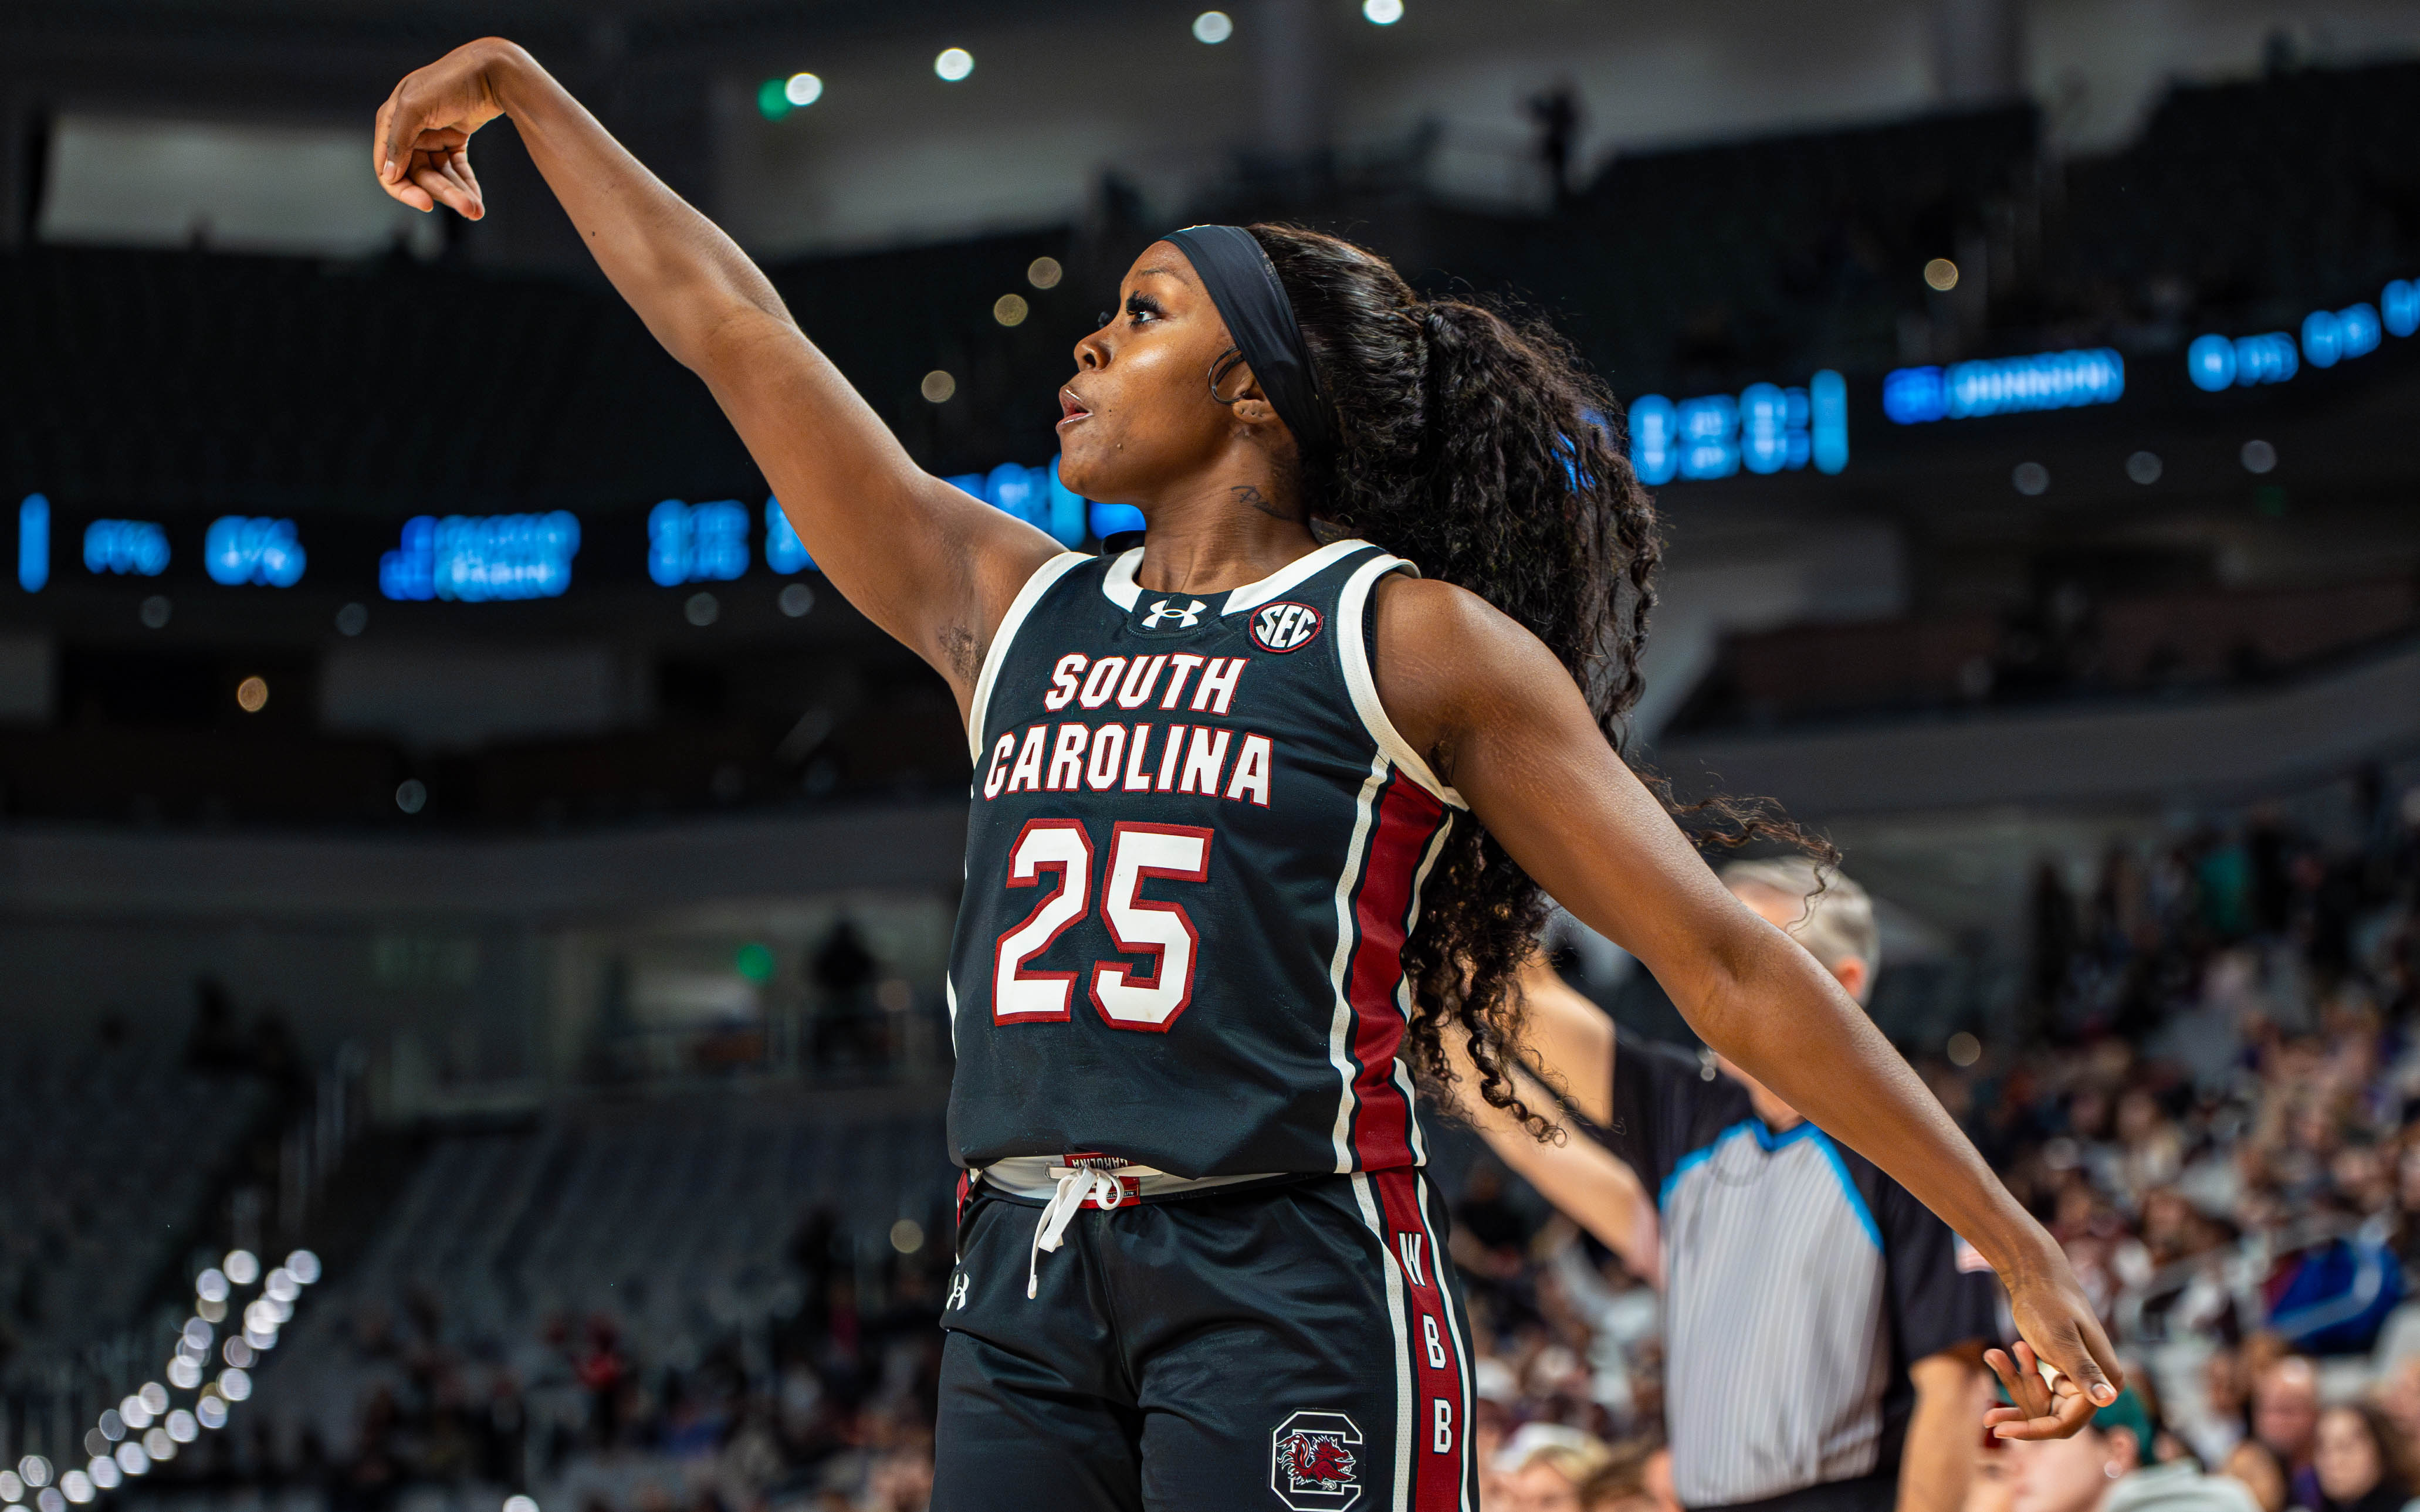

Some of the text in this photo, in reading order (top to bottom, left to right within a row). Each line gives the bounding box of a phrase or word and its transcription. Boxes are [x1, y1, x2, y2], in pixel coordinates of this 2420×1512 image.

[1255, 604, 1316, 648] SEC
[1044, 652, 1250, 716] SOUTH
[984, 722, 1274, 809] CAROLINA
[994, 819, 1214, 1033] 25
